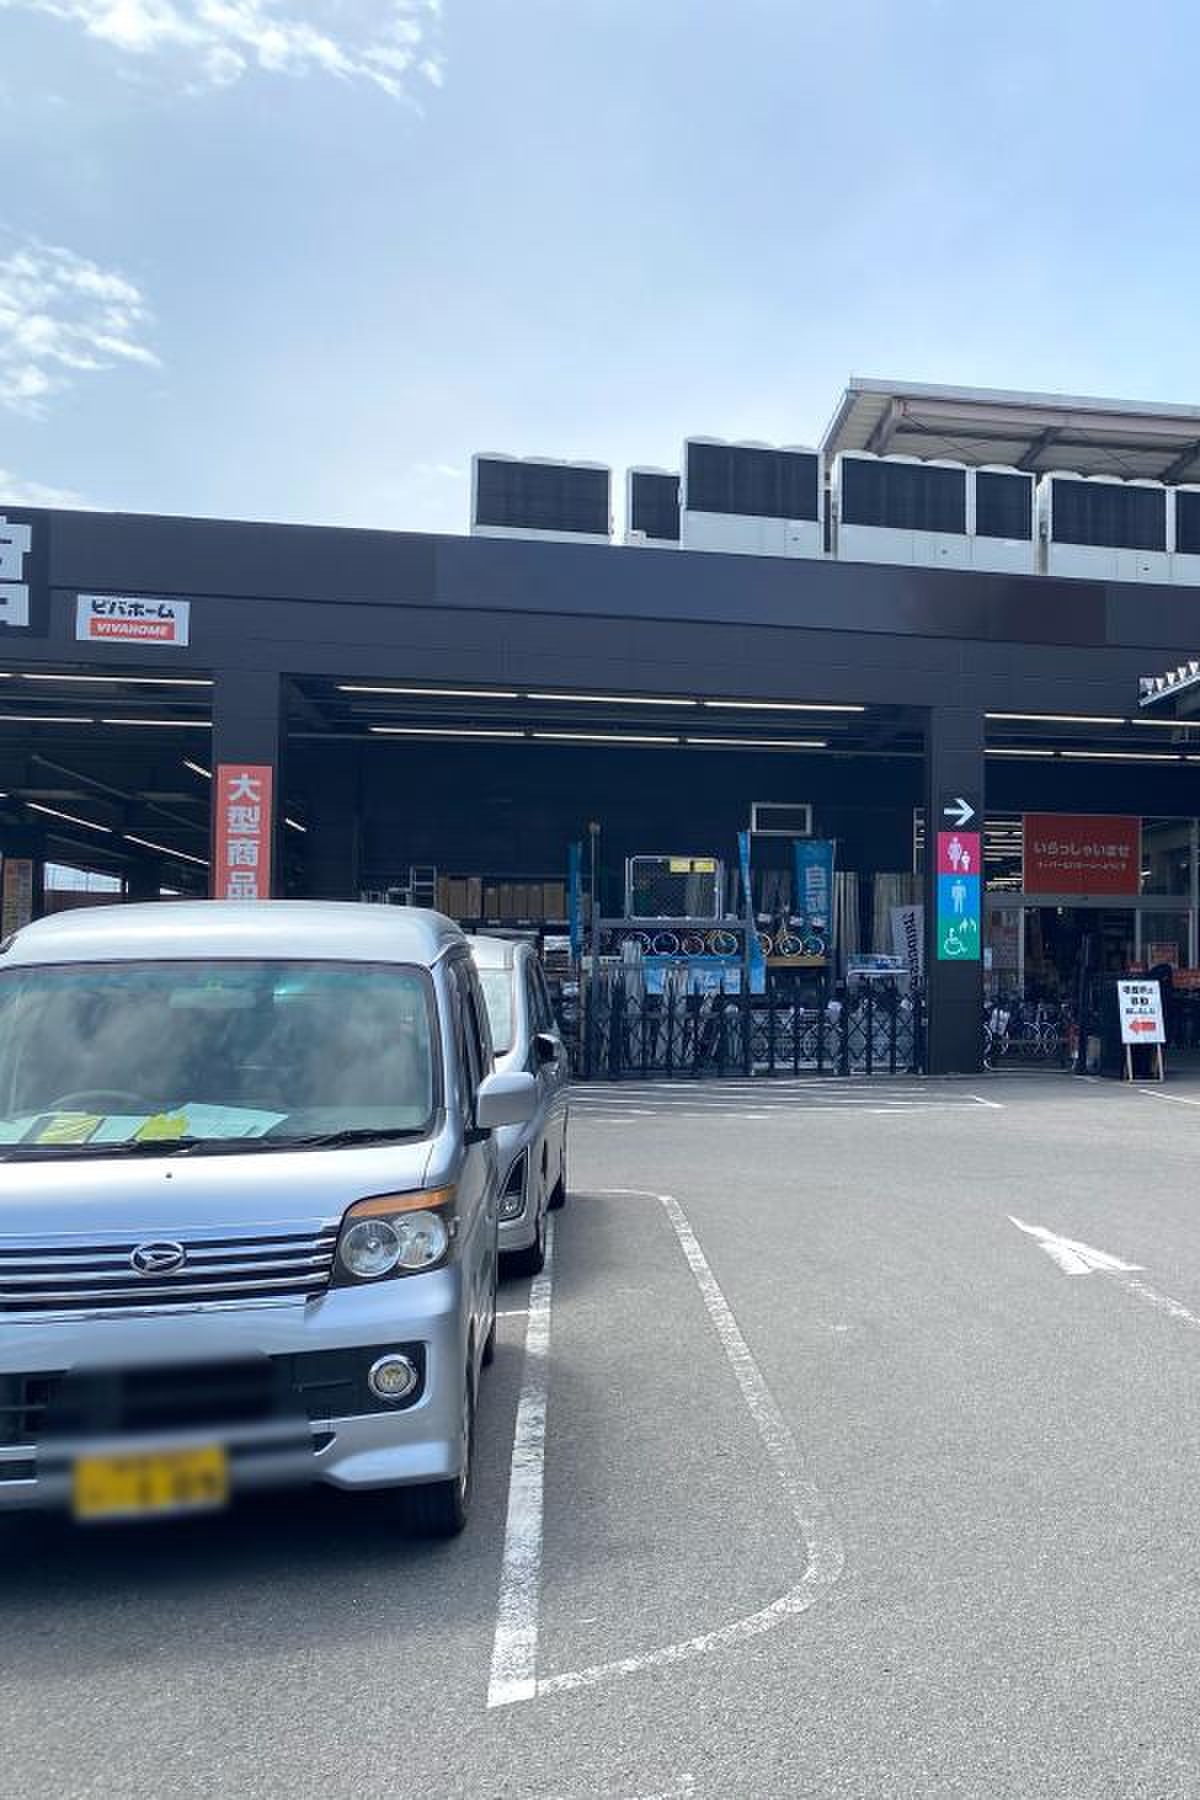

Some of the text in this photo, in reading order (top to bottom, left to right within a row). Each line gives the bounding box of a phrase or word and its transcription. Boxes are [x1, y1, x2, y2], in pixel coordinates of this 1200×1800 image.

[91, 599, 175, 618] ビバホーム
[96, 621, 169, 638] VIVAHOME
[227, 773, 261, 900] 大型商品
[1033, 840, 1130, 858] いらっしゃいませ
